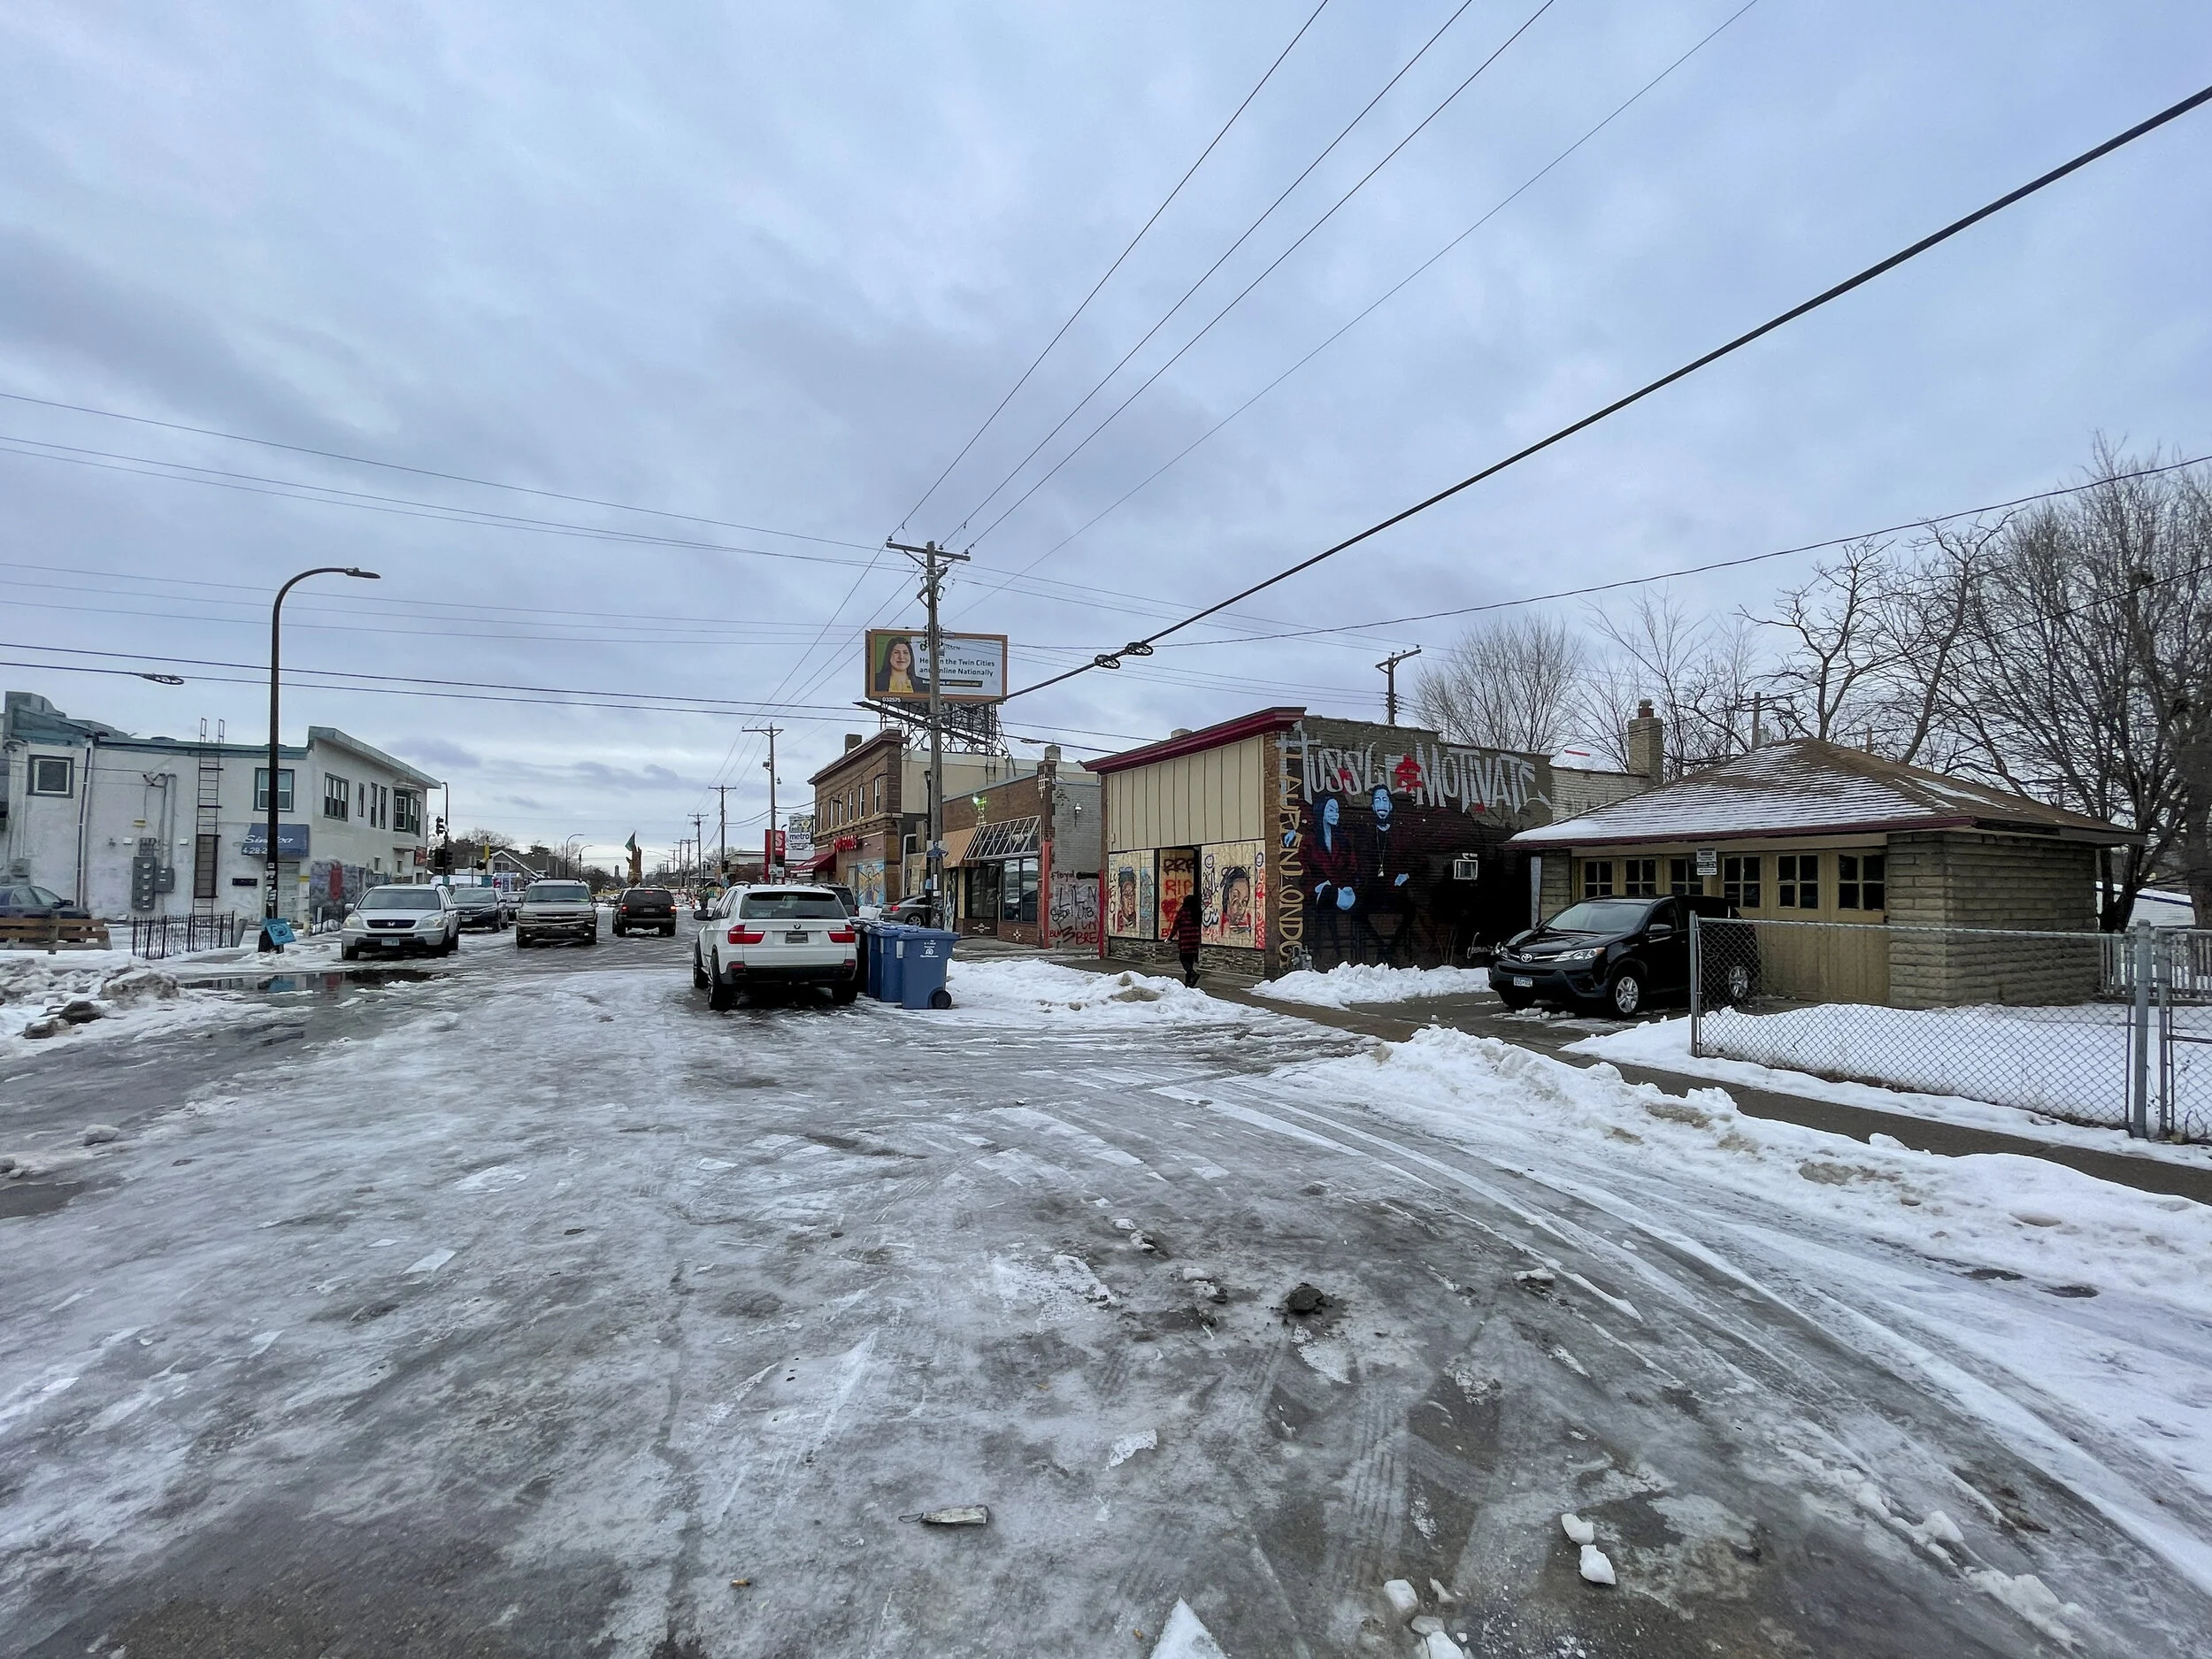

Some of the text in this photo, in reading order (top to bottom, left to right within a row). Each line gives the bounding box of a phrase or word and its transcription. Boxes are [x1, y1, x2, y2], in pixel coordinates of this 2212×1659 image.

[957, 667, 994, 676] Nationally
[1416, 741, 1554, 814] MOTIVATE
[243, 834, 294, 844] Sinoa
[1279, 866, 1304, 970] LONDO
